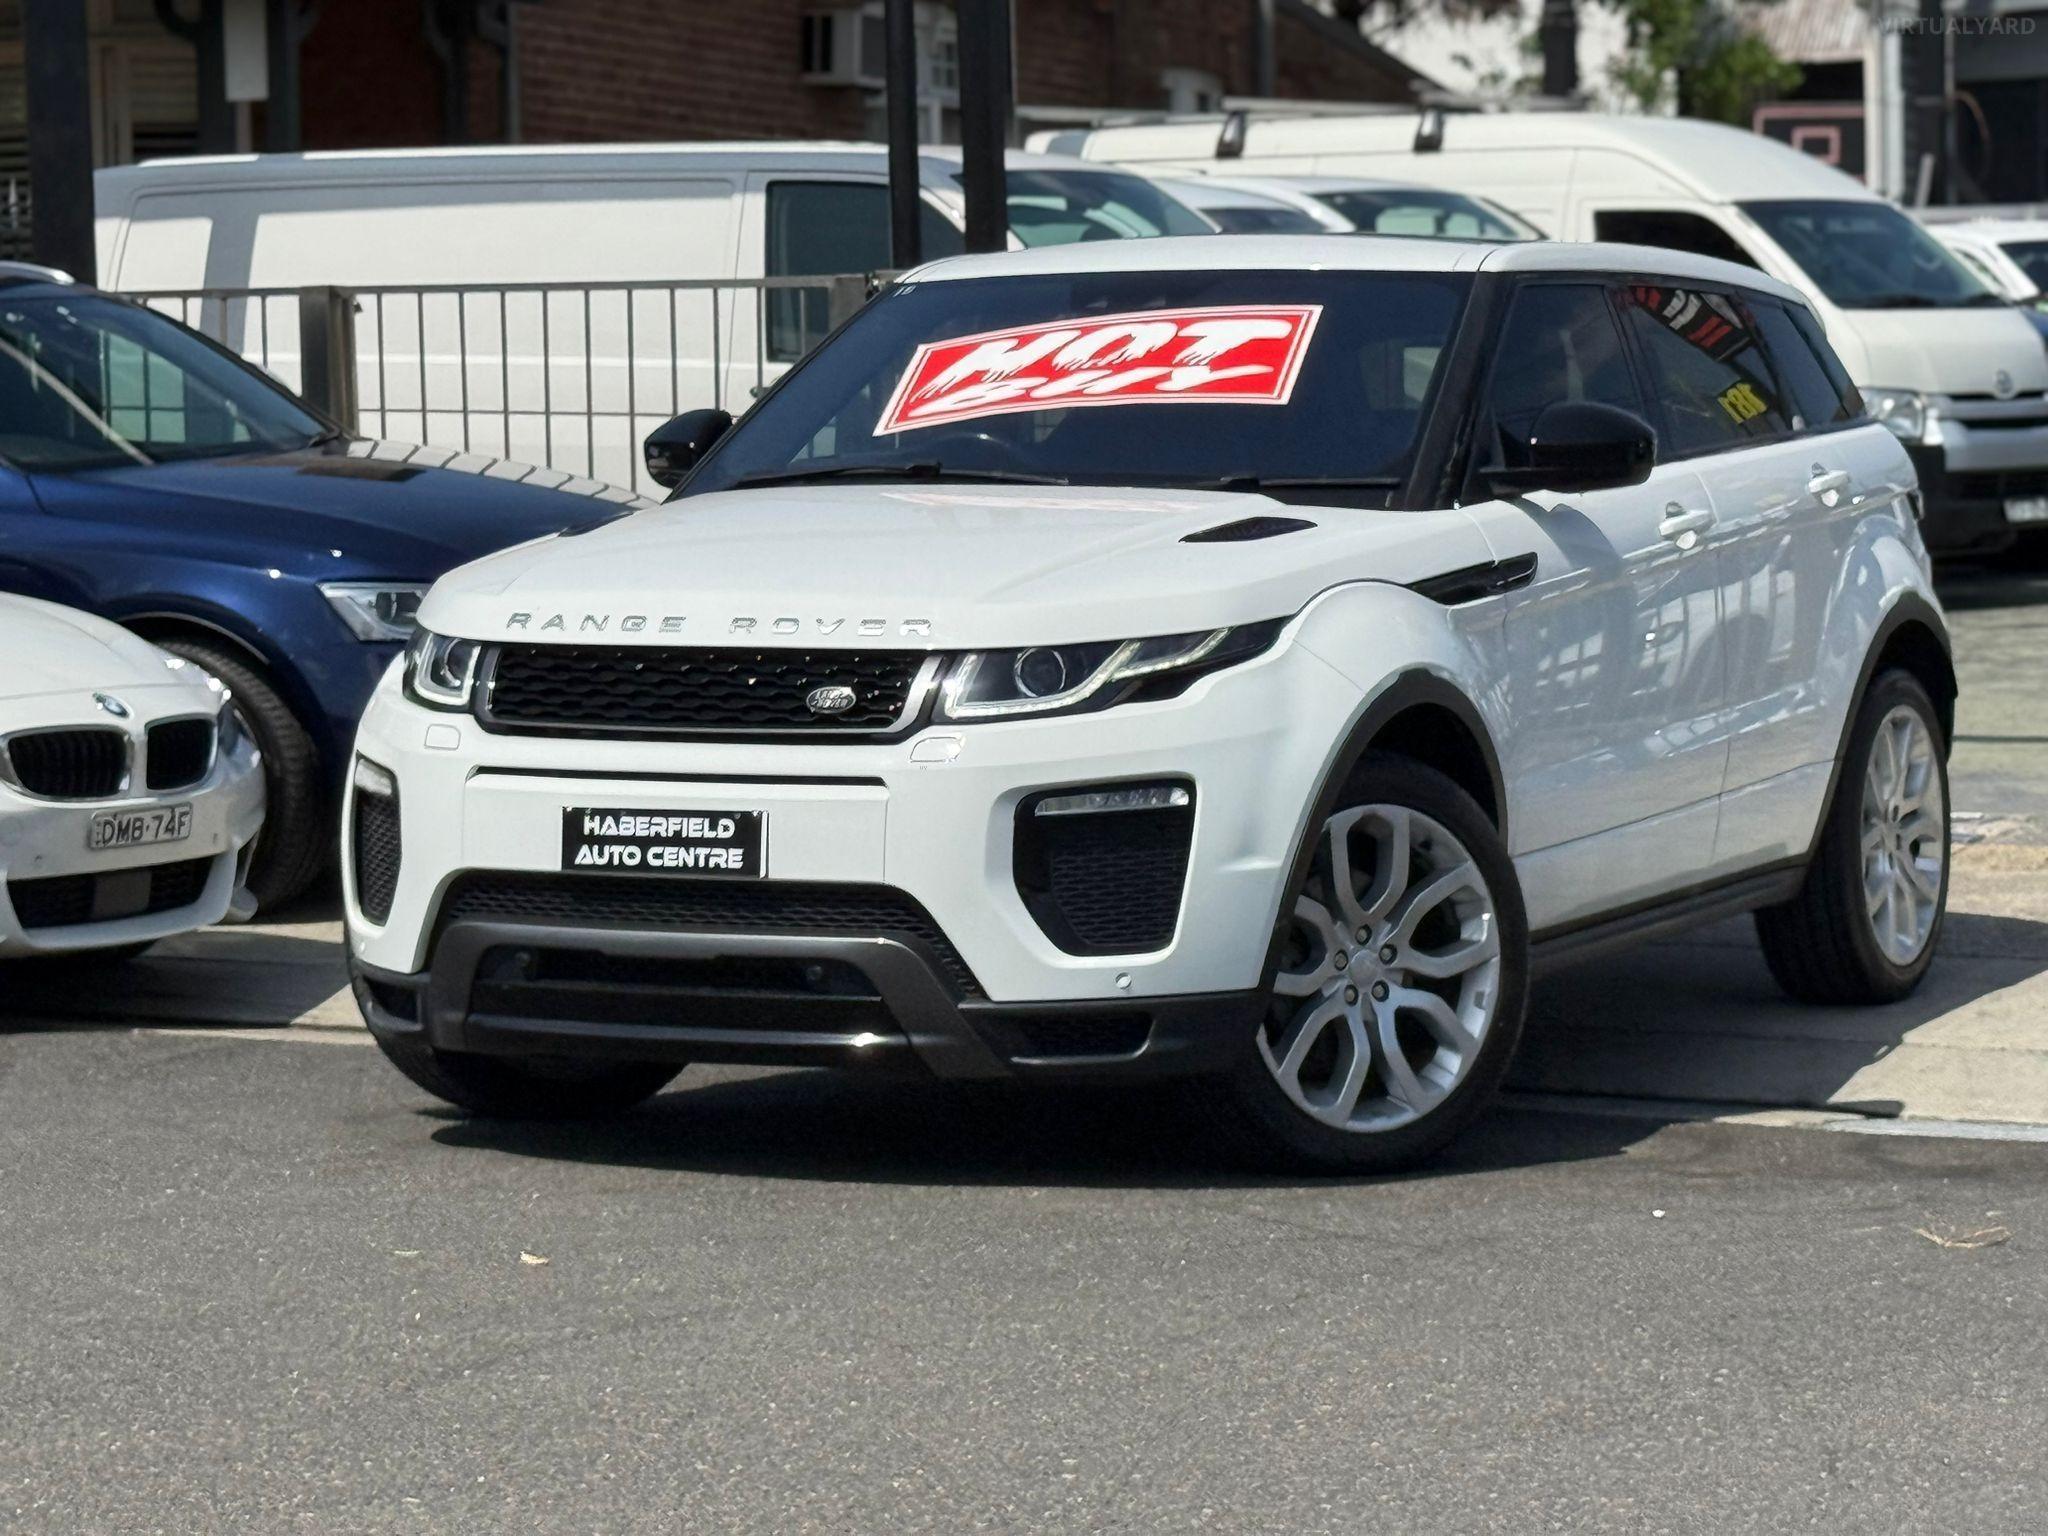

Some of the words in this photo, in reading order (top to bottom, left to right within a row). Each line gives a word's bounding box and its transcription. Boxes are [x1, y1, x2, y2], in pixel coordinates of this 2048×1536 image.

[910, 319, 1293, 404] HOT
[505, 612, 686, 633] RANGE
[728, 616, 932, 637] ROVER
[583, 815, 736, 838] HABERFIELD
[574, 844, 643, 866] AUTO
[646, 846, 745, 869] CENTRE
